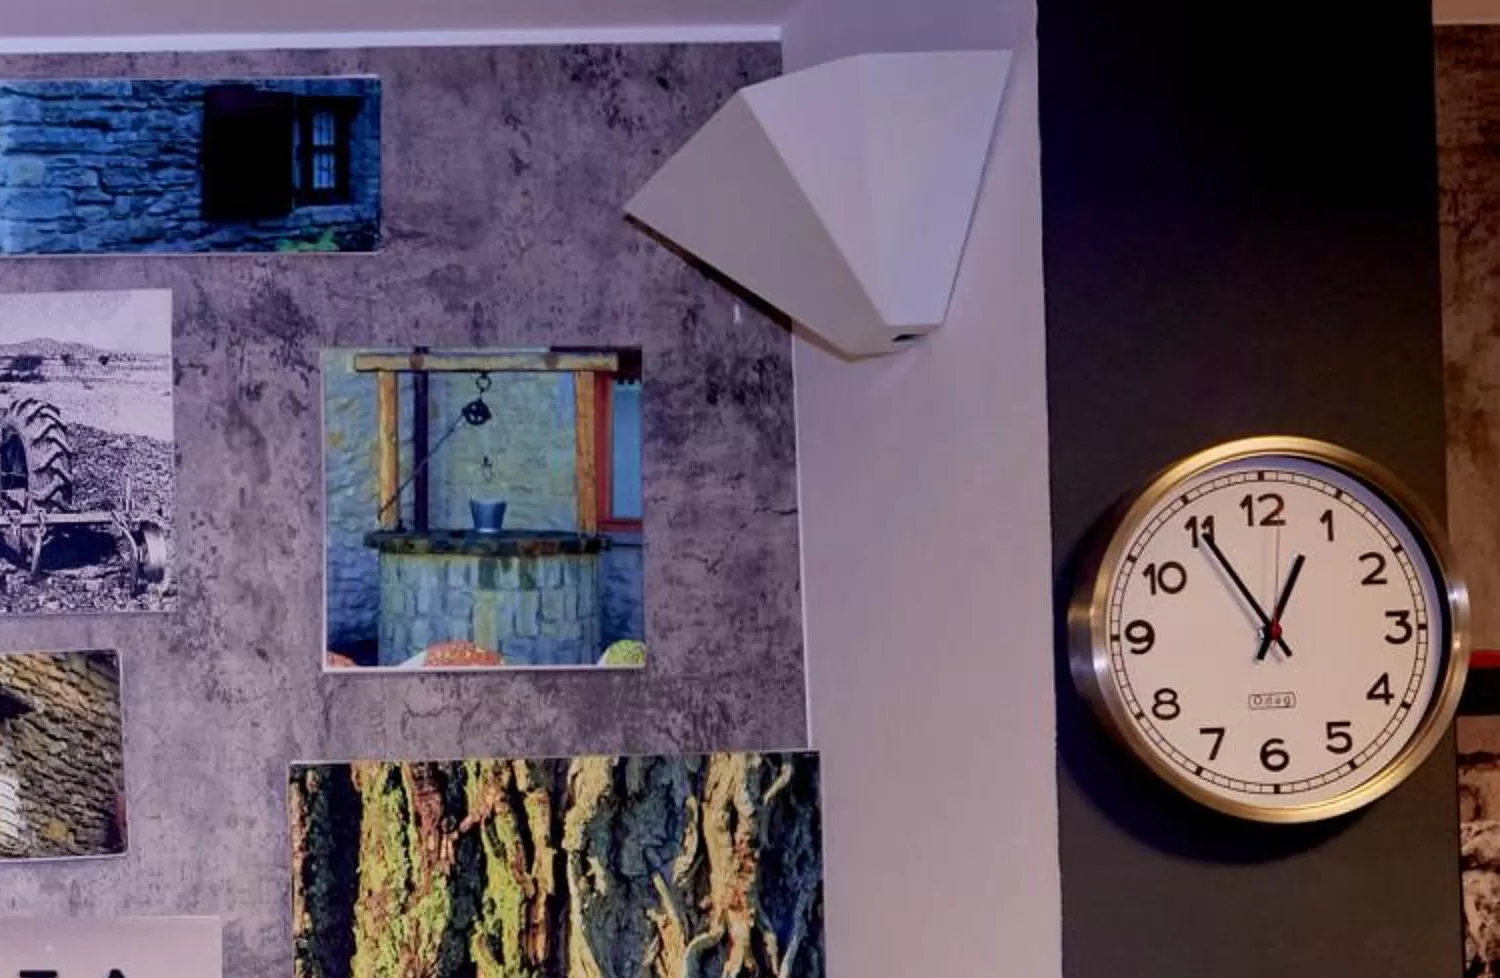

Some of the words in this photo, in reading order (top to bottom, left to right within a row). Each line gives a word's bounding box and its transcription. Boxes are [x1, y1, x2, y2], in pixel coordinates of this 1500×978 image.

[1239, 493, 1286, 527] 12
[1320, 509, 1335, 542] 1
[1185, 515, 1216, 548] 11
[1143, 561, 1188, 596] 10
[1359, 552, 1388, 586] 2
[1125, 619, 1155, 655] 9
[1385, 610, 1413, 645] 3
[1151, 688, 1181, 721] 8
[1366, 673, 1394, 705] 4
[1200, 727, 1226, 761] 7
[1325, 721, 1353, 754] 5
[1260, 738, 1290, 772] 6
